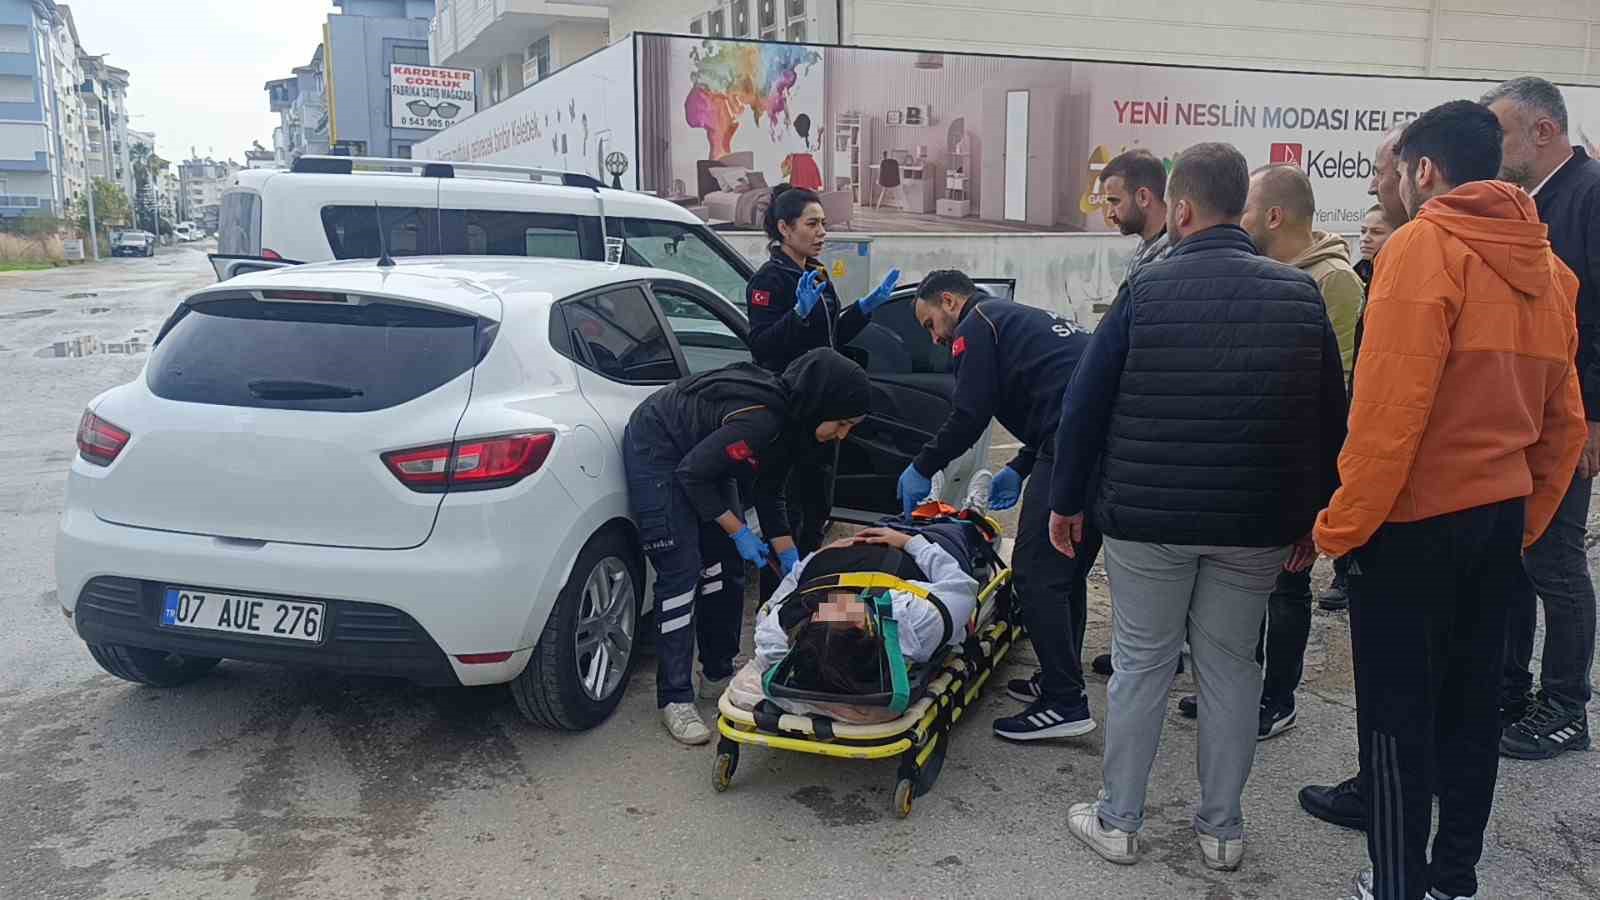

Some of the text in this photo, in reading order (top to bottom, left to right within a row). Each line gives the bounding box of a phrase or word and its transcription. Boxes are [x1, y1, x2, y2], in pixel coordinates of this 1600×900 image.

[1113, 96, 1169, 124] YENİ
[1175, 100, 1257, 128] NESLİN
[1262, 106, 1349, 131] MODASI
[177, 594, 206, 623] 07
[217, 598, 263, 631] AUE
[273, 604, 319, 637] 276
